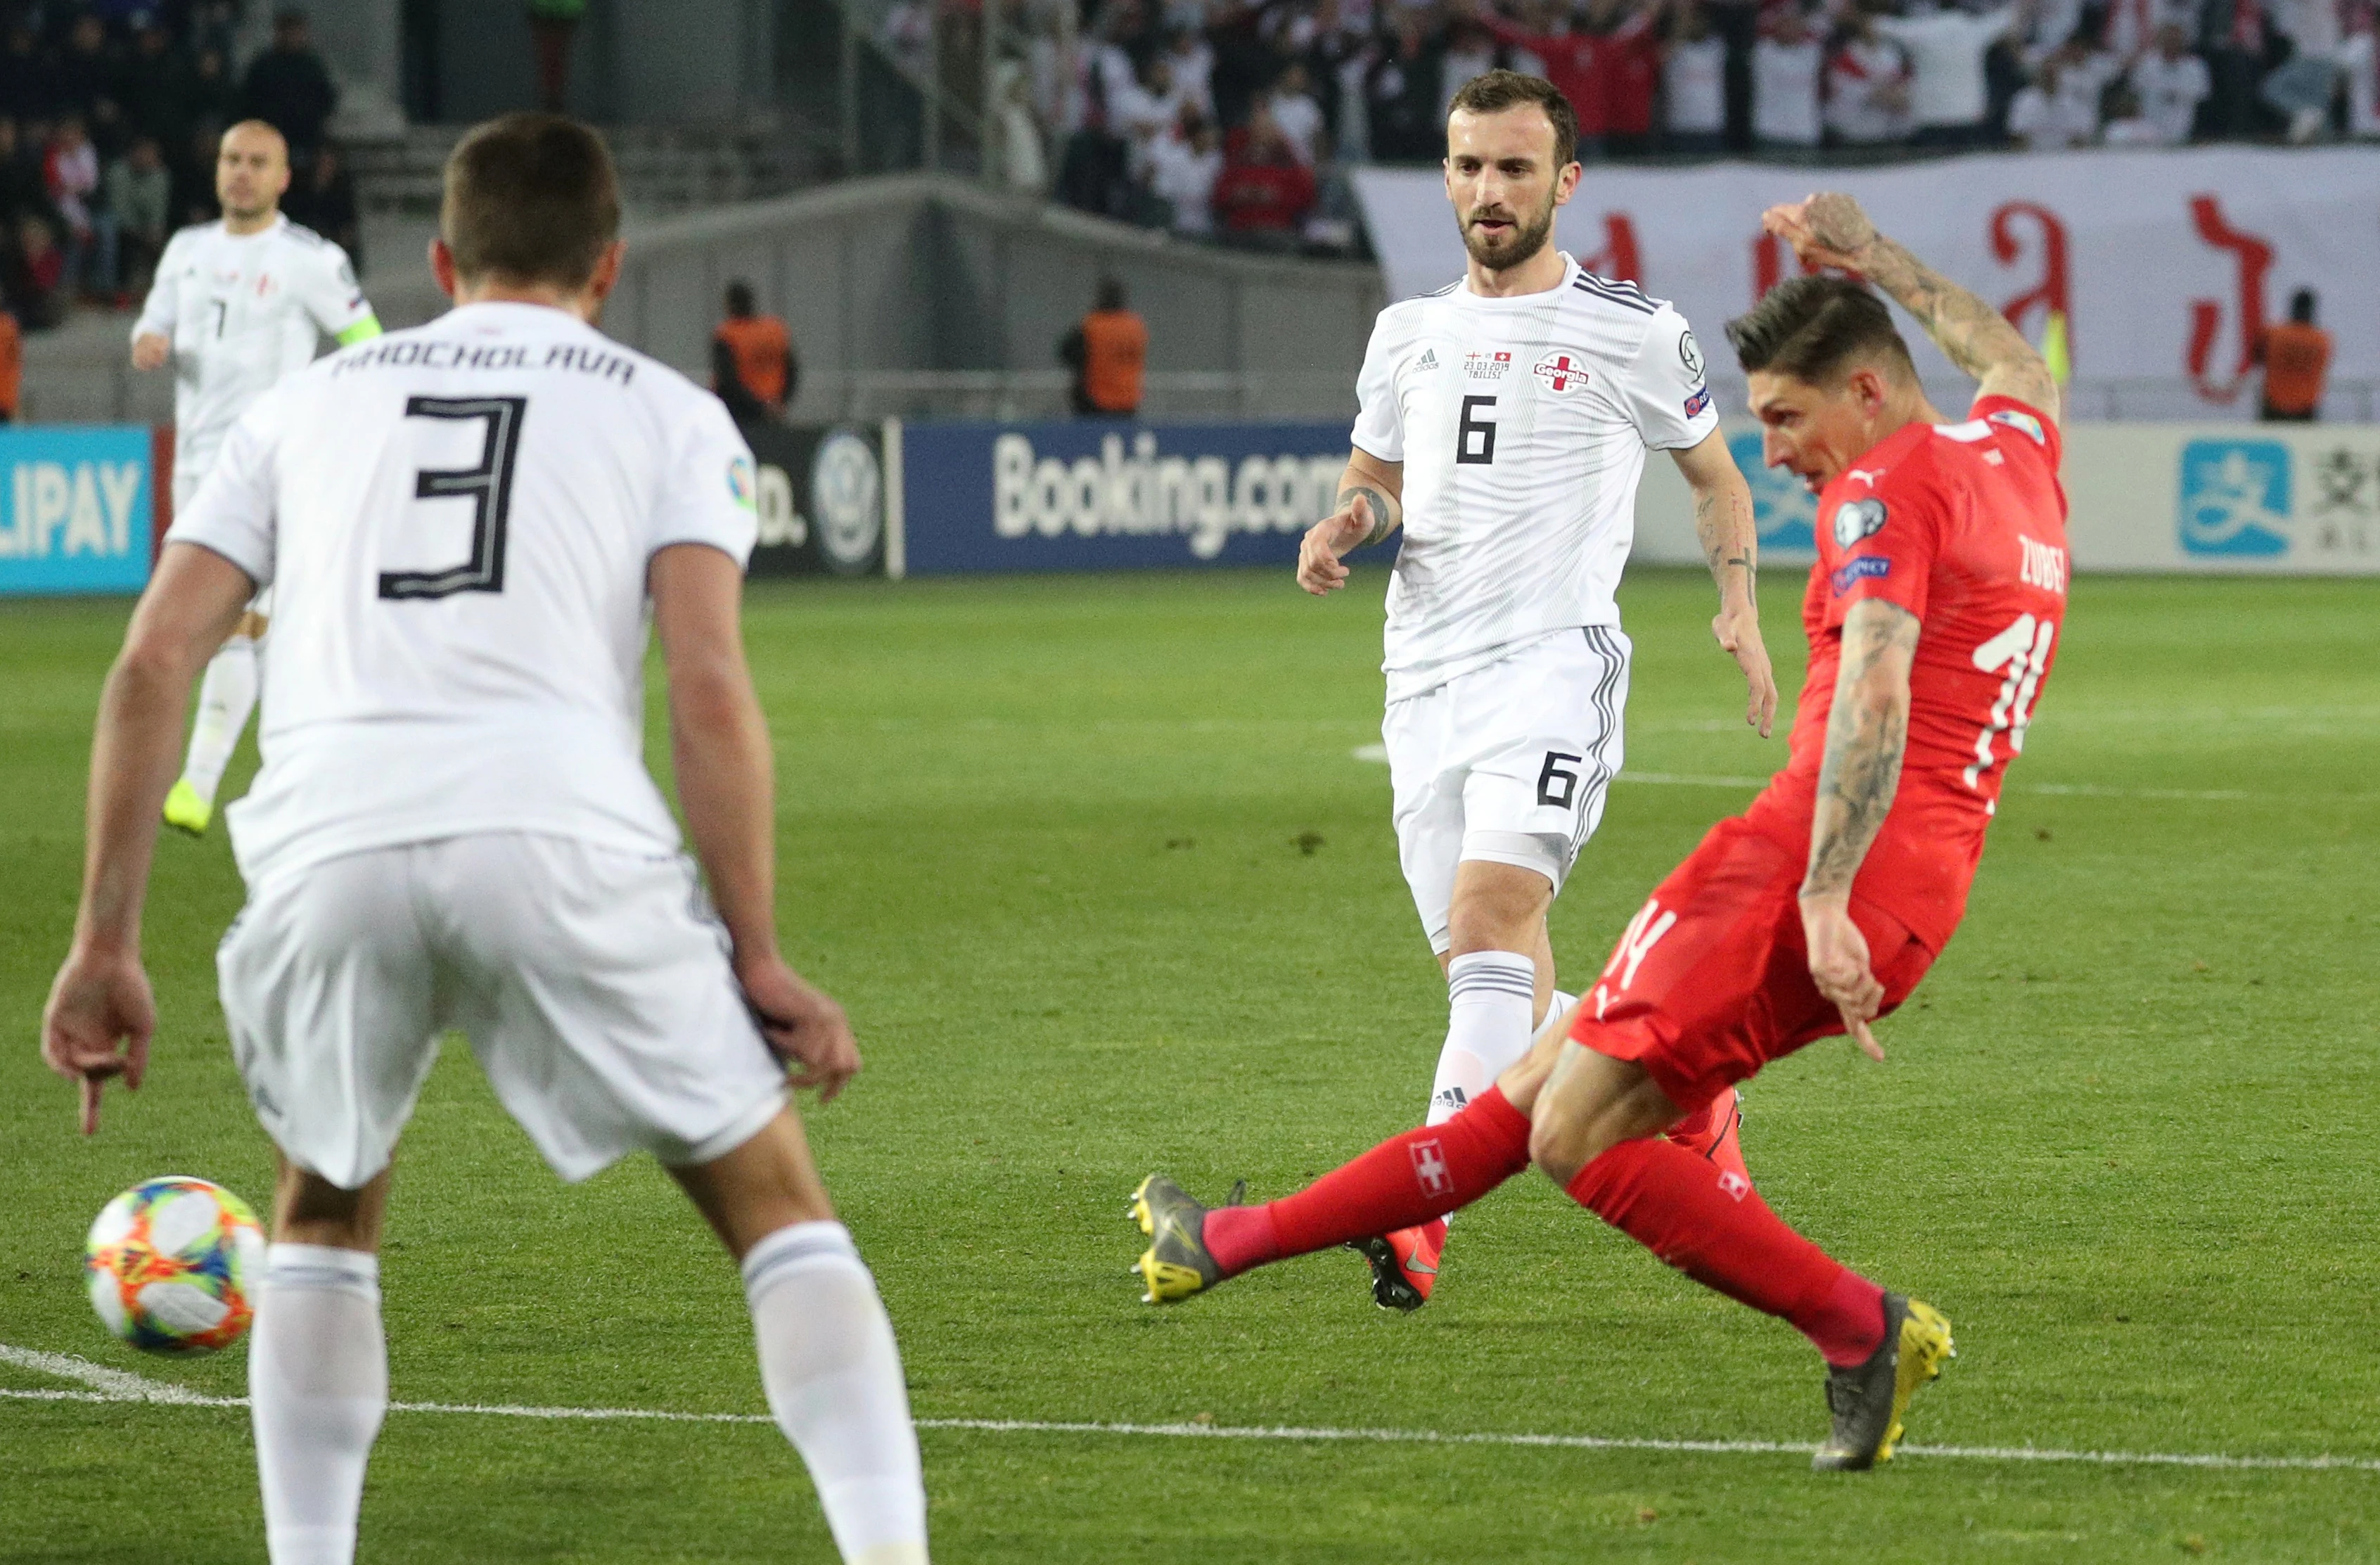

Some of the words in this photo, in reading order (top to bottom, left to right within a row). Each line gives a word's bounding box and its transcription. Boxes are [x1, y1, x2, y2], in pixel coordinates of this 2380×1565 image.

[211, 298, 226, 338] 7
[1464, 362, 1509, 371] 23.03.2019
[1469, 371, 1502, 379] TBILISI
[1535, 363, 1588, 385] Georgia
[1457, 395, 1497, 464] 6
[378, 396, 528, 599] 3
[1537, 750, 1582, 811] 6
